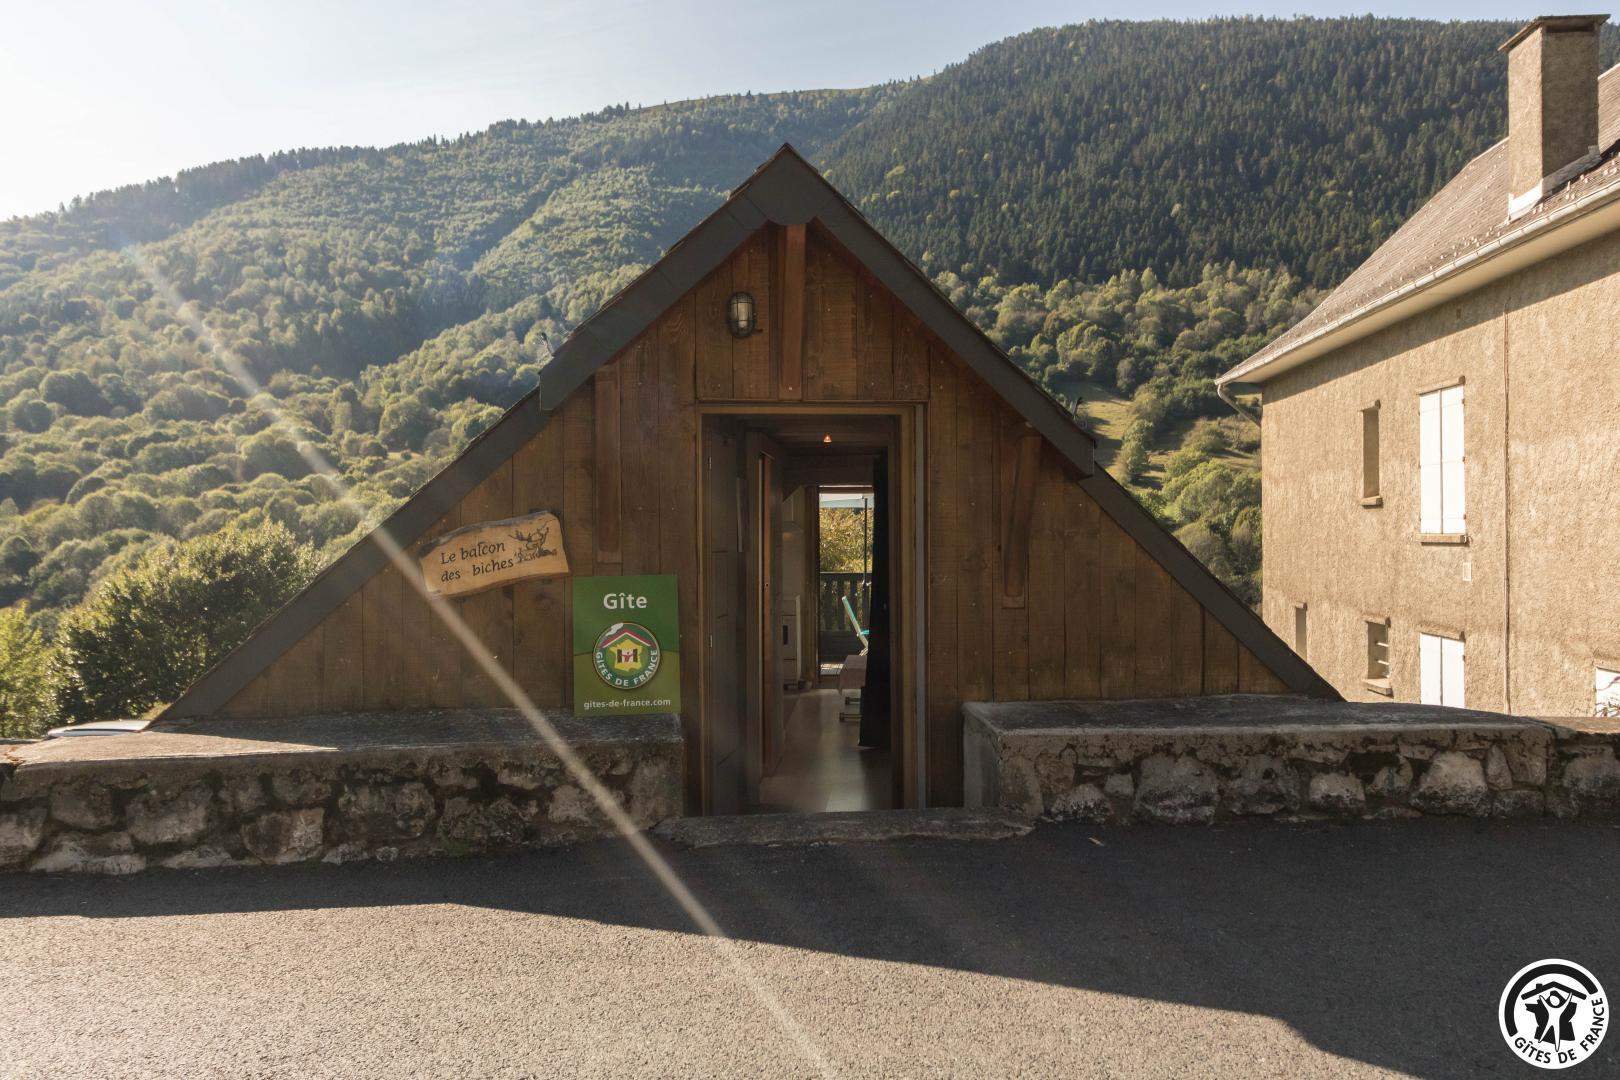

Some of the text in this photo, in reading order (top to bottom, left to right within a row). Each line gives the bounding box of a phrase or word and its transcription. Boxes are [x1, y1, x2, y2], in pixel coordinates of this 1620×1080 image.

[441, 541, 506, 565] Le balcon
[441, 558, 514, 582] des biches
[603, 592, 648, 610] Gîte
[615, 678, 629, 687] DE
[633, 649, 658, 685] FRANCE
[583, 698, 671, 710] gites-de-france.com
